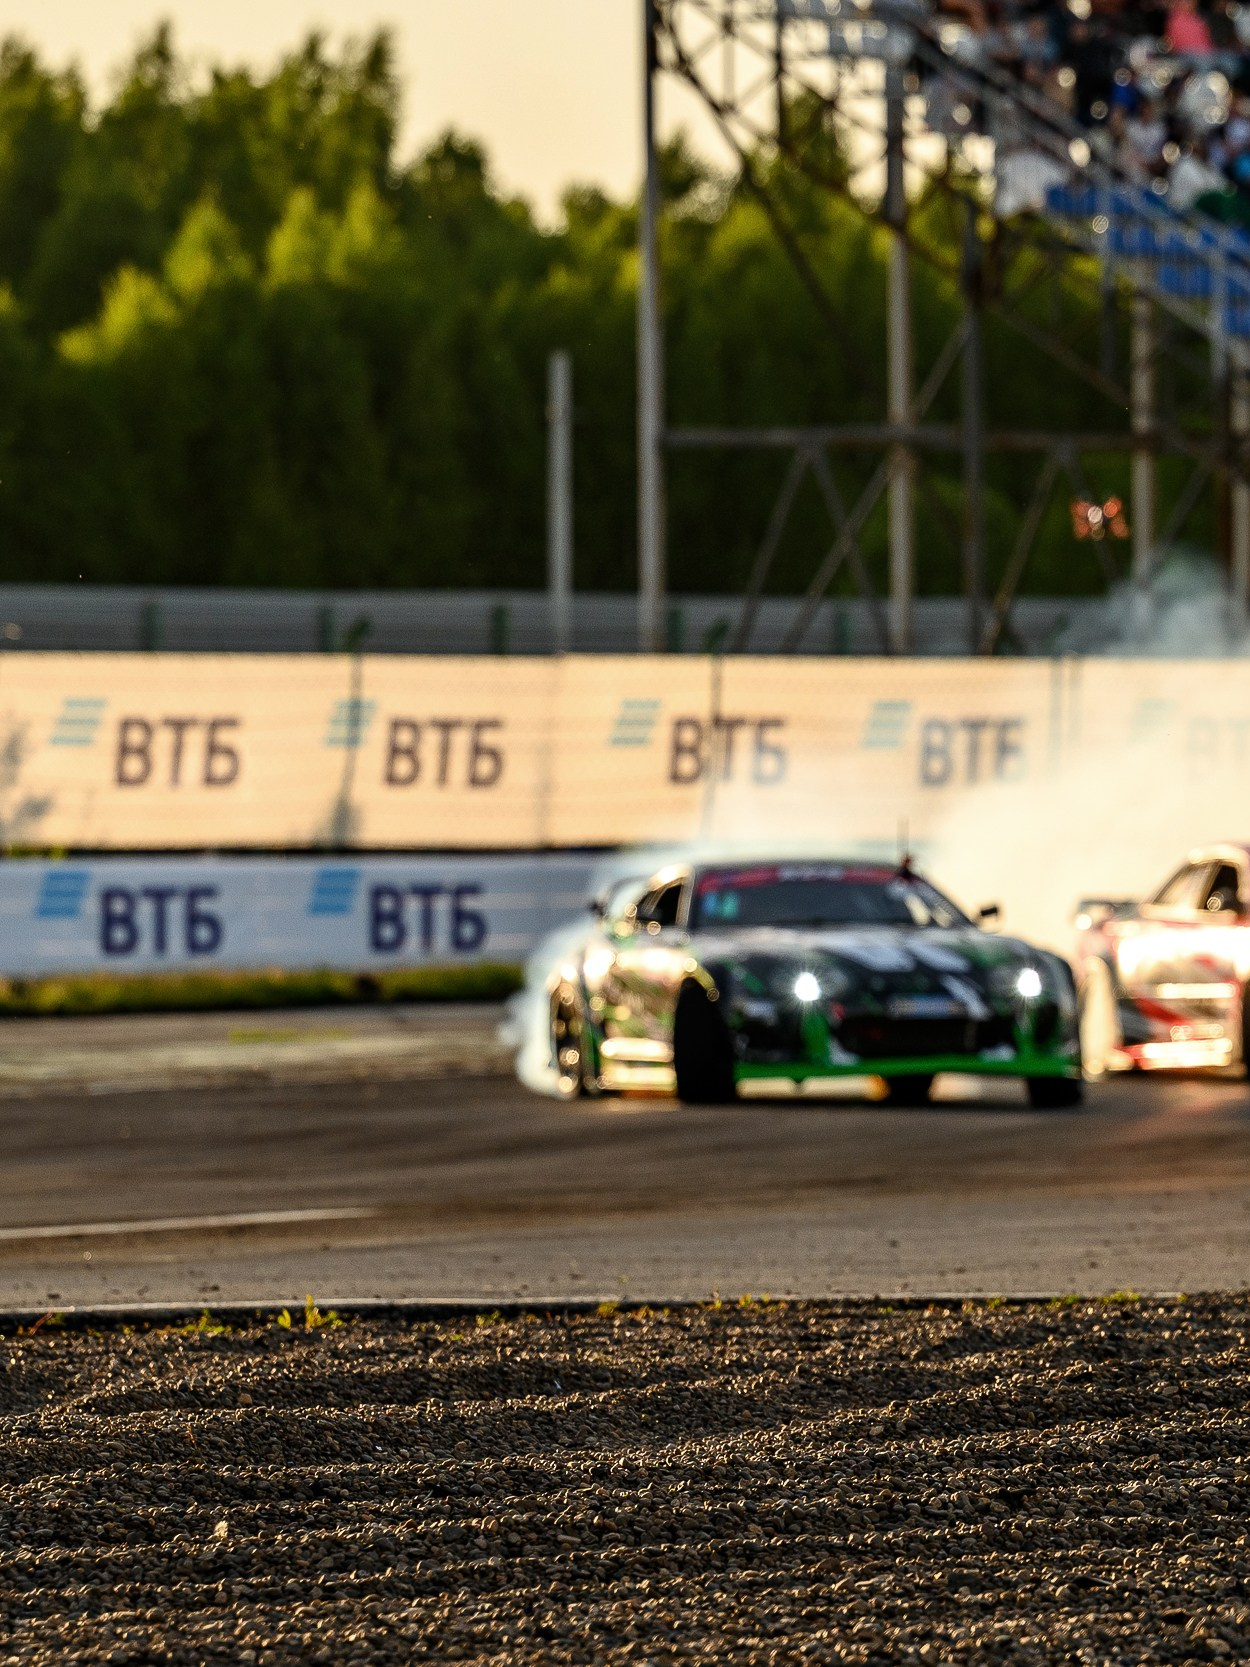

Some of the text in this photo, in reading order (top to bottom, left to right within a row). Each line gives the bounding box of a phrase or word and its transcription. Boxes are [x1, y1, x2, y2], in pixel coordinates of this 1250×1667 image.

[116, 716, 242, 788] ВТБ
[384, 717, 506, 788] ВТБ
[669, 715, 789, 786] ВТБ
[920, 715, 1030, 784] ВТБ
[100, 886, 223, 955] ВТБ
[369, 883, 488, 954] ВТБ
